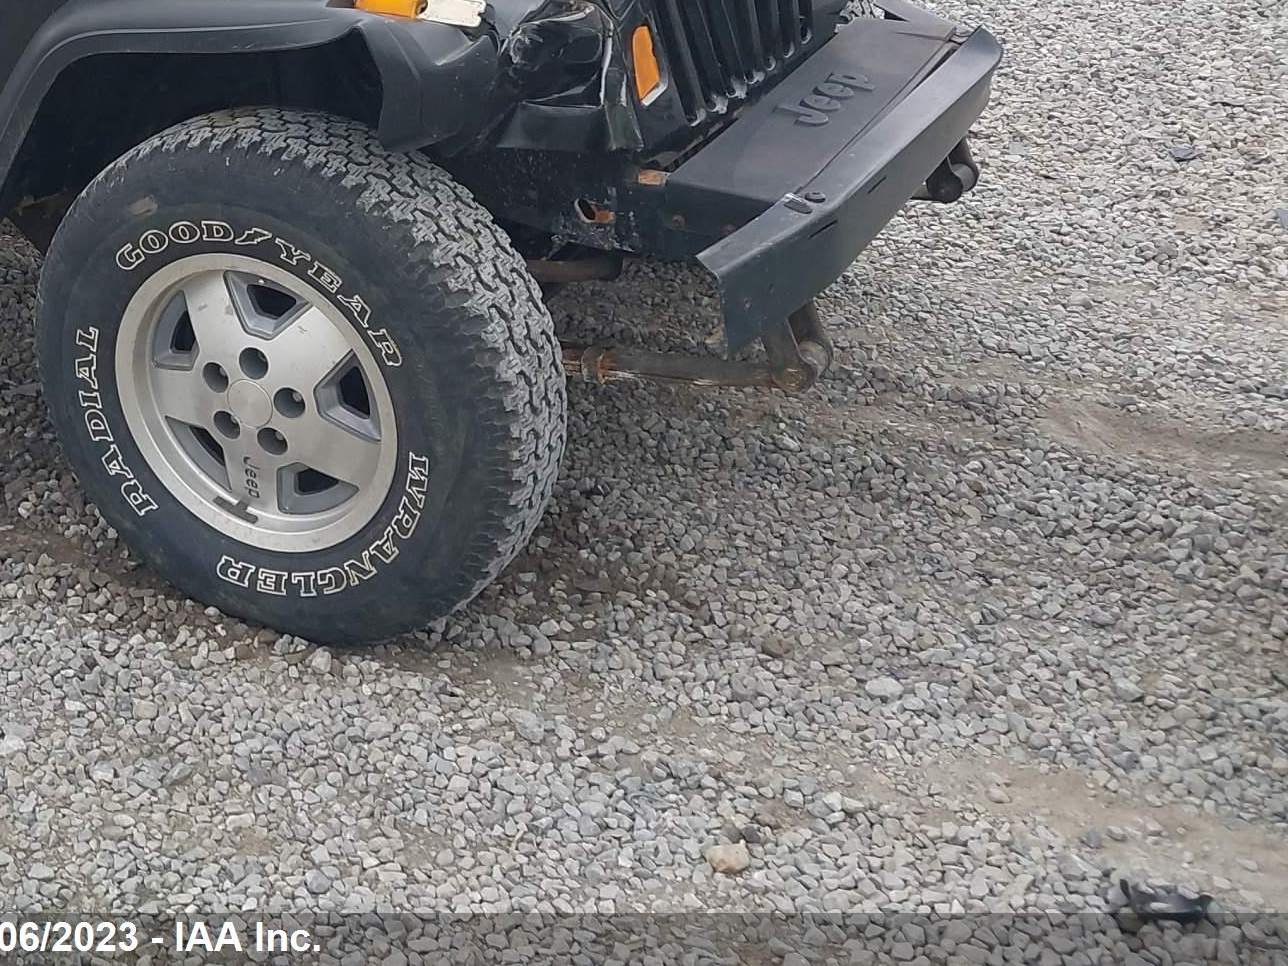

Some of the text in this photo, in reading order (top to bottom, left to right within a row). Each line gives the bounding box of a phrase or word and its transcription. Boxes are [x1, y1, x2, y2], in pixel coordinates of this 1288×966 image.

[772, 71, 876, 127] Jeep
[74, 325, 159, 516] RADIAL
[216, 452, 430, 597] WRANGLER
[243, 455, 260, 498] Jeep
